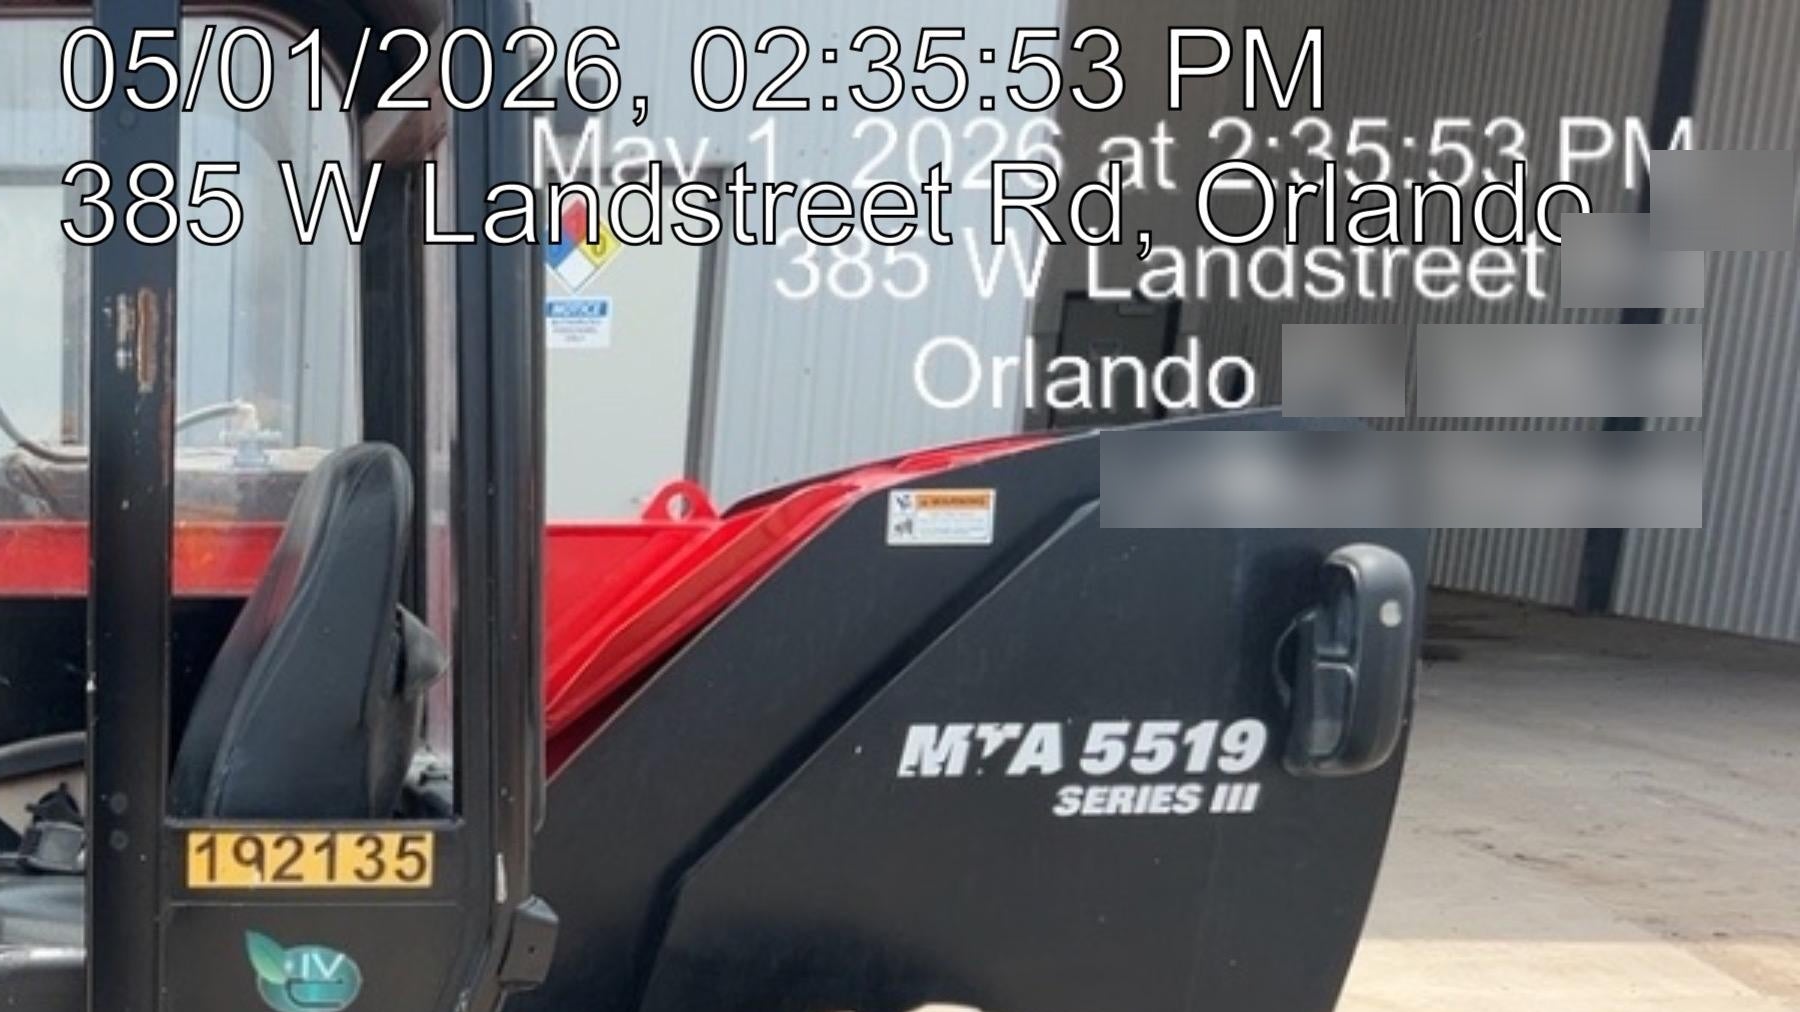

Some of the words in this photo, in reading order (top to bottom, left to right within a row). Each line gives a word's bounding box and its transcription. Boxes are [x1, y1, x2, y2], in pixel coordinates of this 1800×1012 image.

[1079, 718, 1268, 776] 5519
[1052, 784, 1203, 817] SERIES
[1209, 782, 1261, 813] III
[195, 833, 428, 882] 192135
